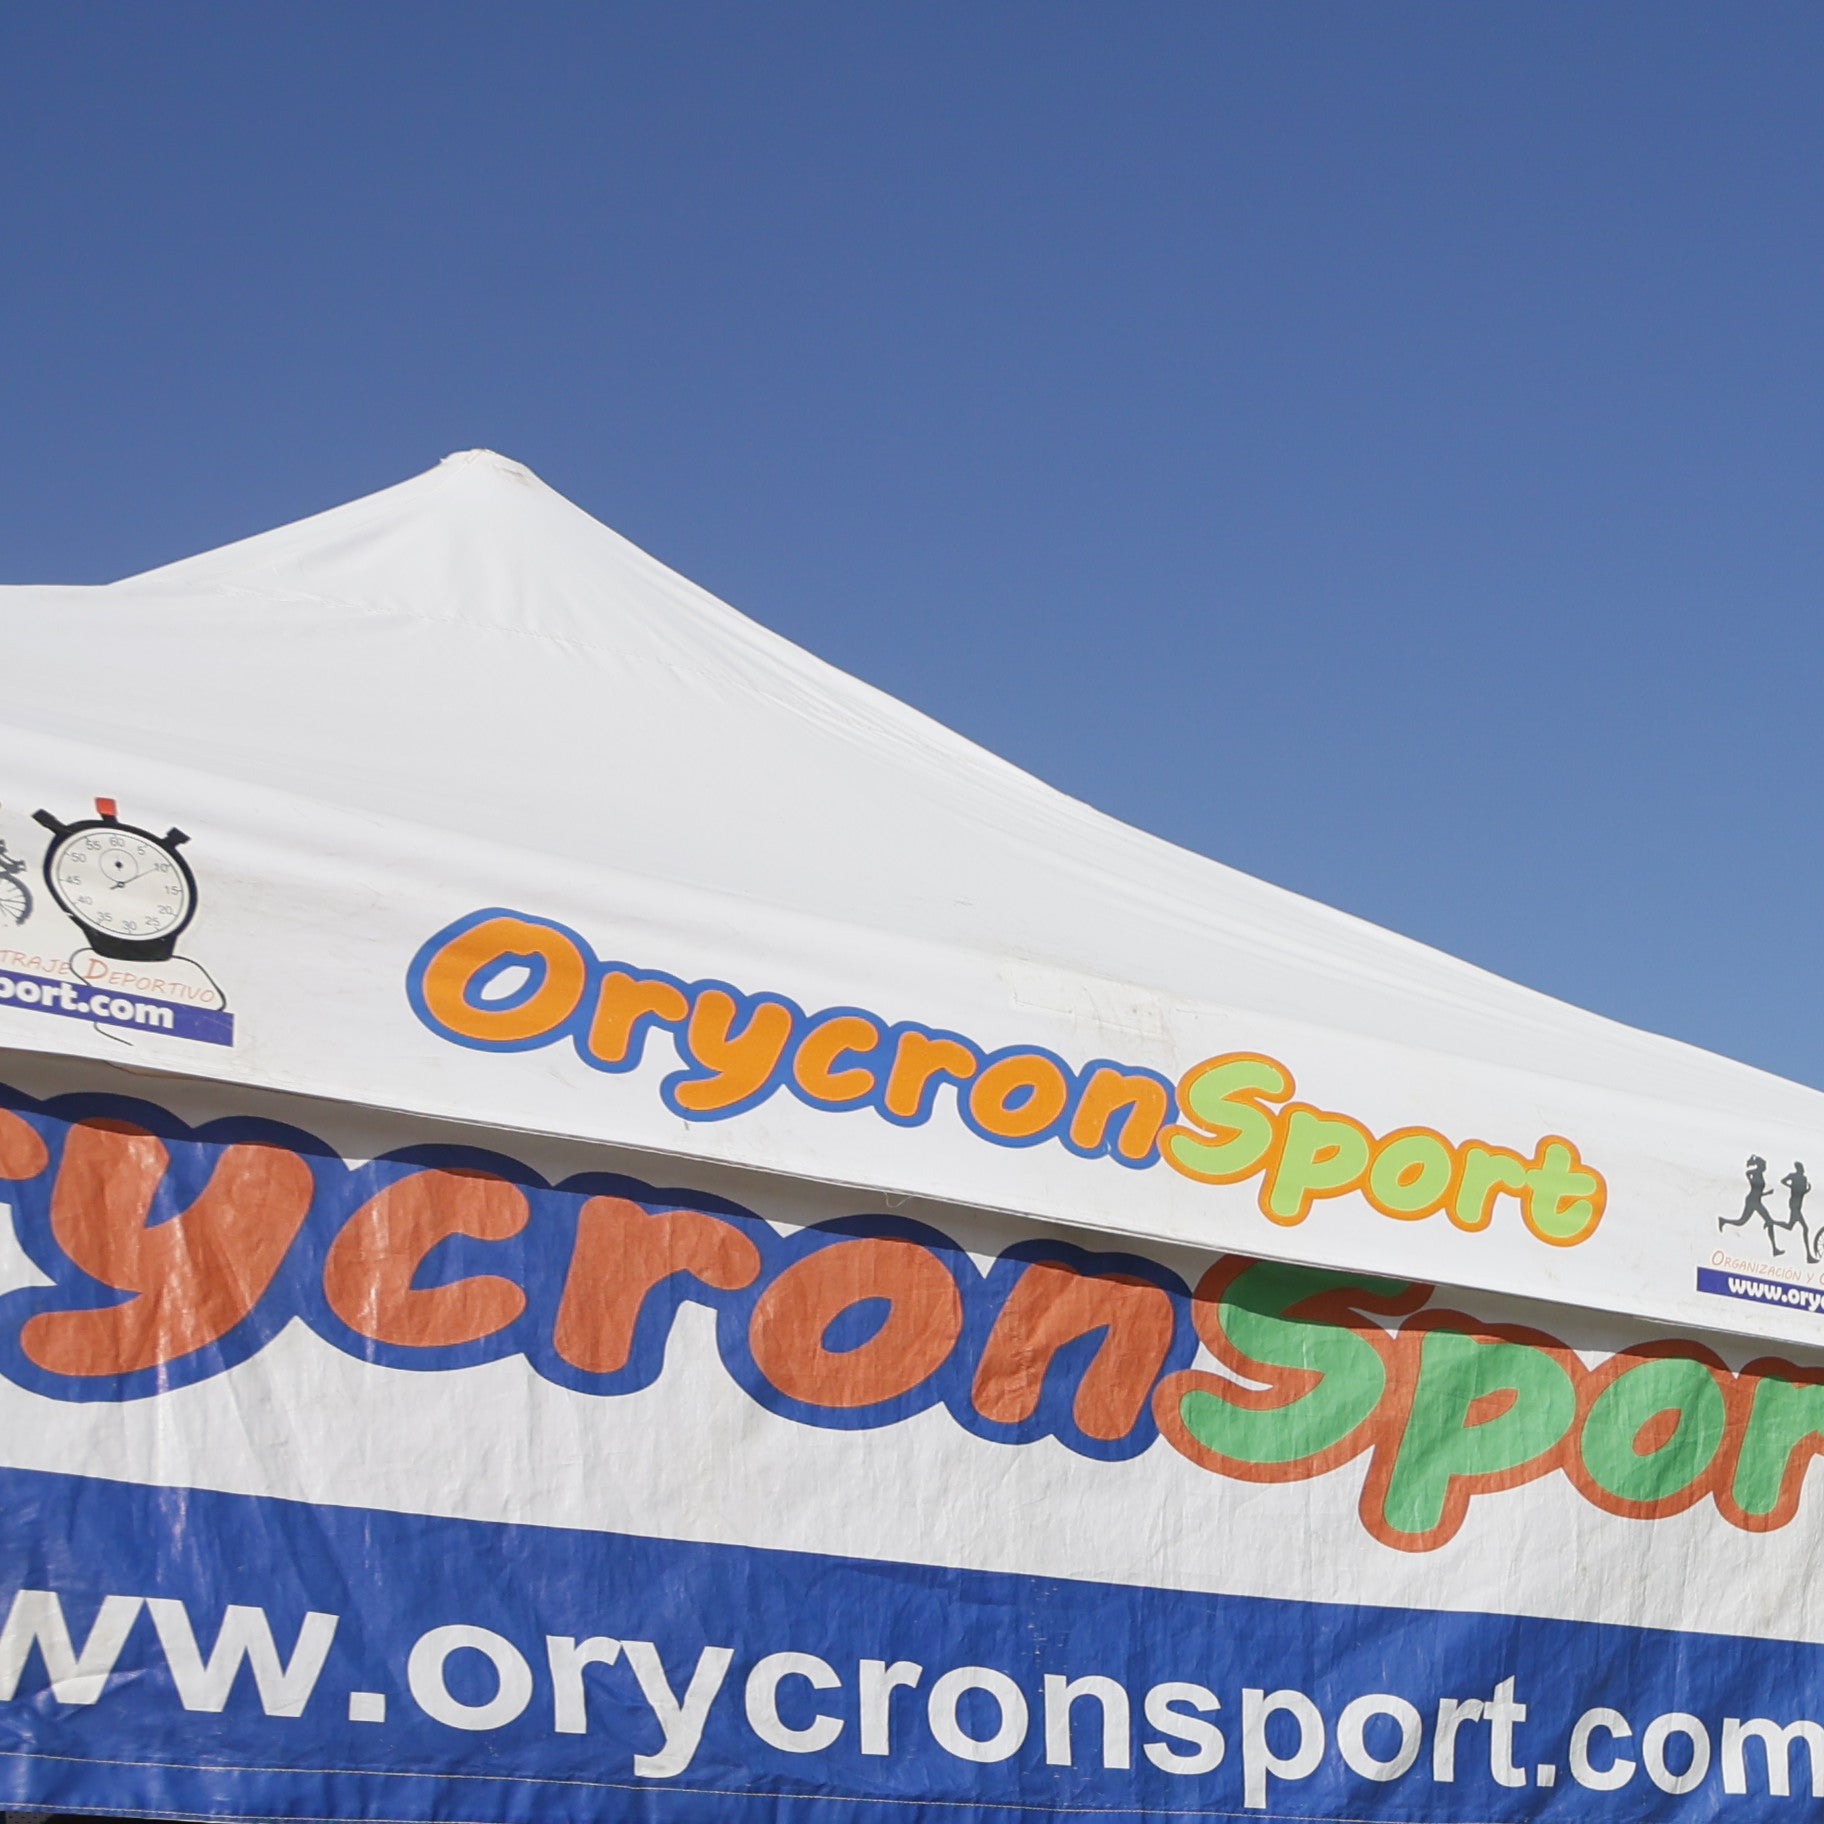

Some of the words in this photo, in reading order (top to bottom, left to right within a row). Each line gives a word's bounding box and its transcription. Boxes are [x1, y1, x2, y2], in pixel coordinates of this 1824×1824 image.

[86, 838, 102, 851] 55
[110, 836, 125, 848] 60
[137, 844, 147, 856] 5
[71, 851, 88, 863] 50
[66, 874, 82, 886] 45
[165, 884, 179, 896] 15
[77, 895, 93, 906] 40
[159, 904, 173, 916] 20
[98, 911, 113, 923] 35
[145, 915, 160, 927] 25
[123, 920, 137, 932] 30
[84, 958, 216, 1004] DEPORTIVO
[406, 907, 1606, 1248] OrycronSport
